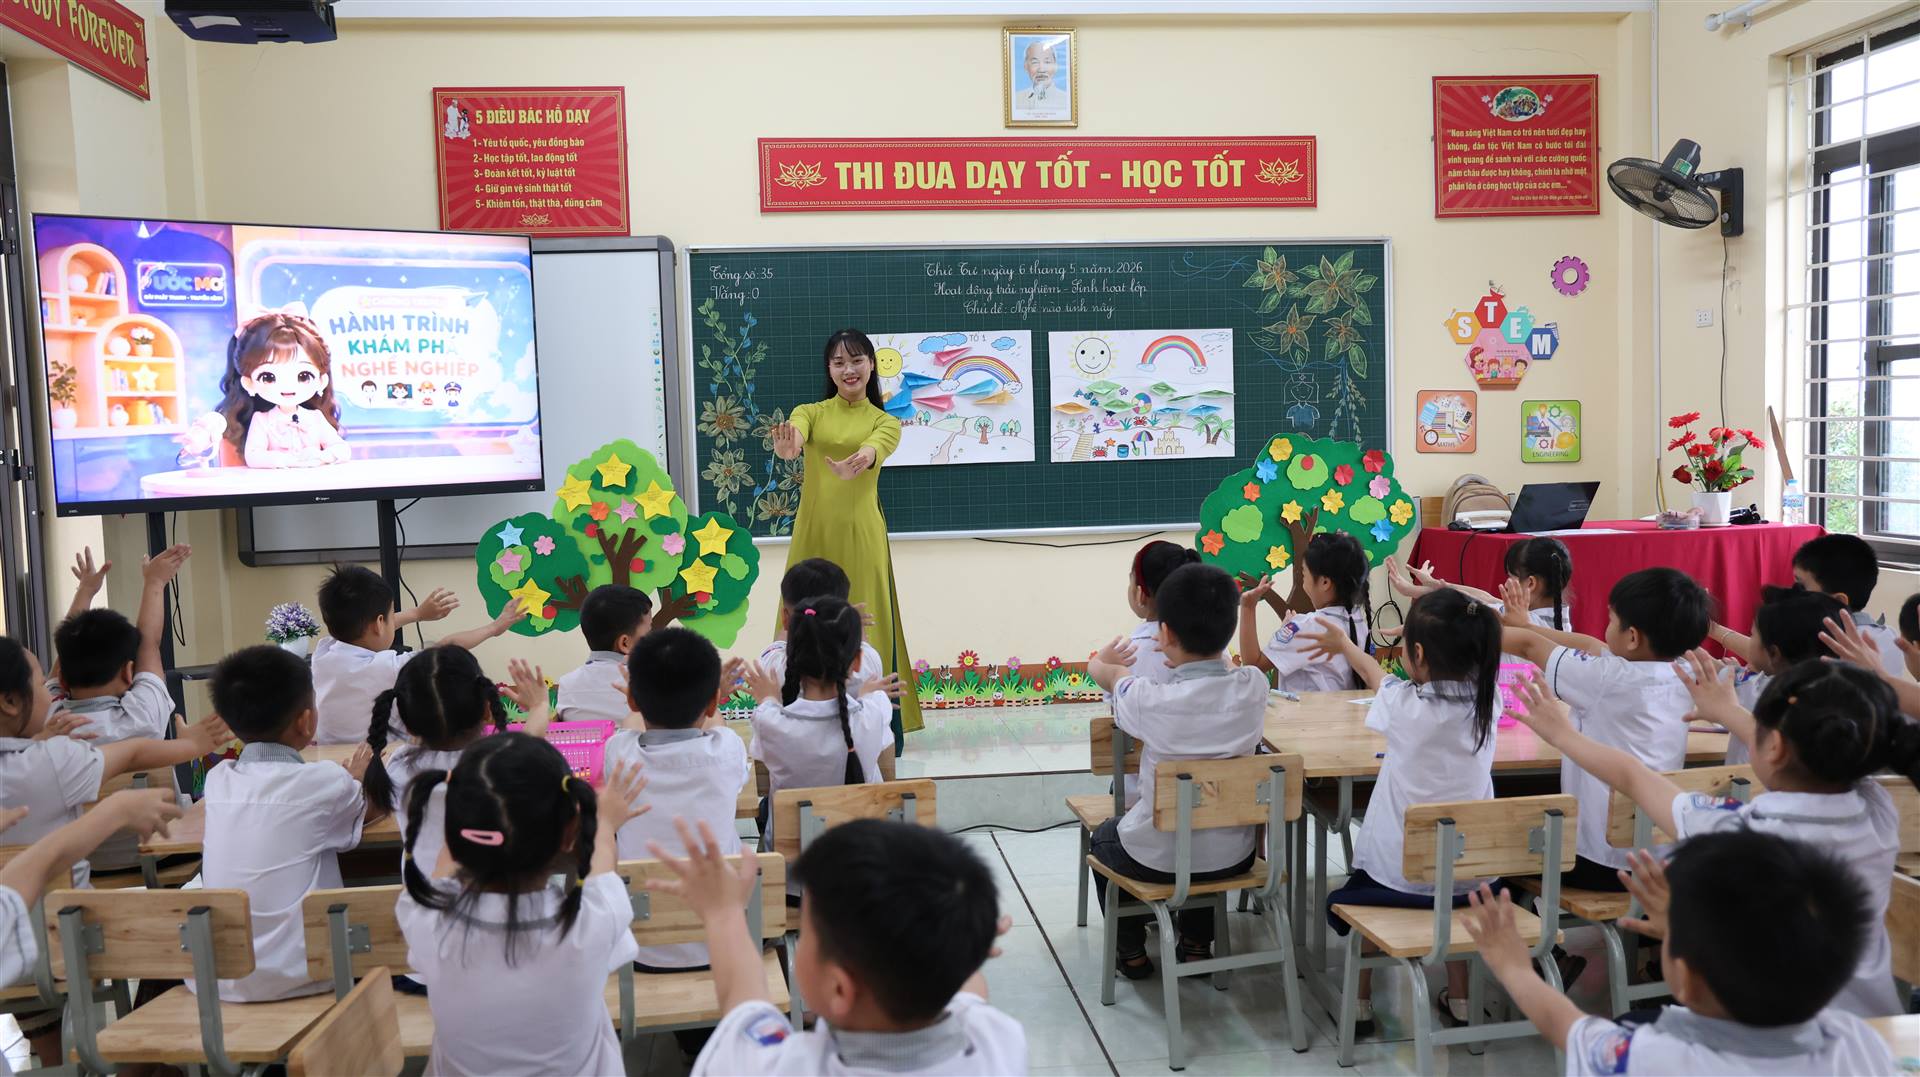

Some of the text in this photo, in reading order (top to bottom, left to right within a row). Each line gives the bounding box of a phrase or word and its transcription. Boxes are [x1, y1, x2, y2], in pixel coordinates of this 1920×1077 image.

[68, 0, 136, 68] FOREVER
[475, 104, 590, 126] 5 ĐIỀU BÁC HỒ DẠY
[1482, 128, 1496, 138] Việt
[1497, 128, 1512, 136] Nam
[1574, 128, 1586, 137] hay
[1501, 142, 1515, 151] Việt
[1518, 141, 1532, 149] Nam
[483, 153, 500, 165] Học
[501, 153, 515, 165] tập
[531, 153, 544, 162] lao
[566, 152, 578, 162] tốt
[1463, 157, 1484, 165] quang
[1512, 155, 1522, 163] vai
[1570, 153, 1586, 163] quốc
[506, 168, 520, 178] kết
[547, 168, 563, 179] luật
[564, 167, 576, 177] tốt
[834, 161, 884, 190] THI
[894, 161, 956, 190] ĐUA
[966, 161, 1026, 195] DẠY
[1036, 150, 1090, 189] TỐT
[1122, 159, 1183, 194] HỌC
[1192, 149, 1245, 187] TỐT
[1498, 168, 1510, 178] hay
[1574, 167, 1587, 176] một
[524, 183, 541, 192] sinh
[543, 183, 559, 194] thật
[560, 182, 572, 192] tốt
[1500, 182, 1511, 191] học
[1513, 181, 1524, 191] tập
[529, 198, 546, 209] thật
[709, 265, 741, 287] Tổng
[924, 262, 953, 276] Thứ
[983, 264, 1014, 281] ngày
[1019, 264, 1025, 275] 6
[1070, 263, 1076, 274] 5
[1080, 263, 1114, 274] năm
[1116, 261, 1143, 273] 2026
[934, 282, 962, 298] Hoạt
[1103, 279, 1127, 295] hoạt
[1130, 278, 1147, 298] lớp
[329, 312, 469, 335] HÀNH TRÌNH
[348, 334, 410, 355] KHÁM
